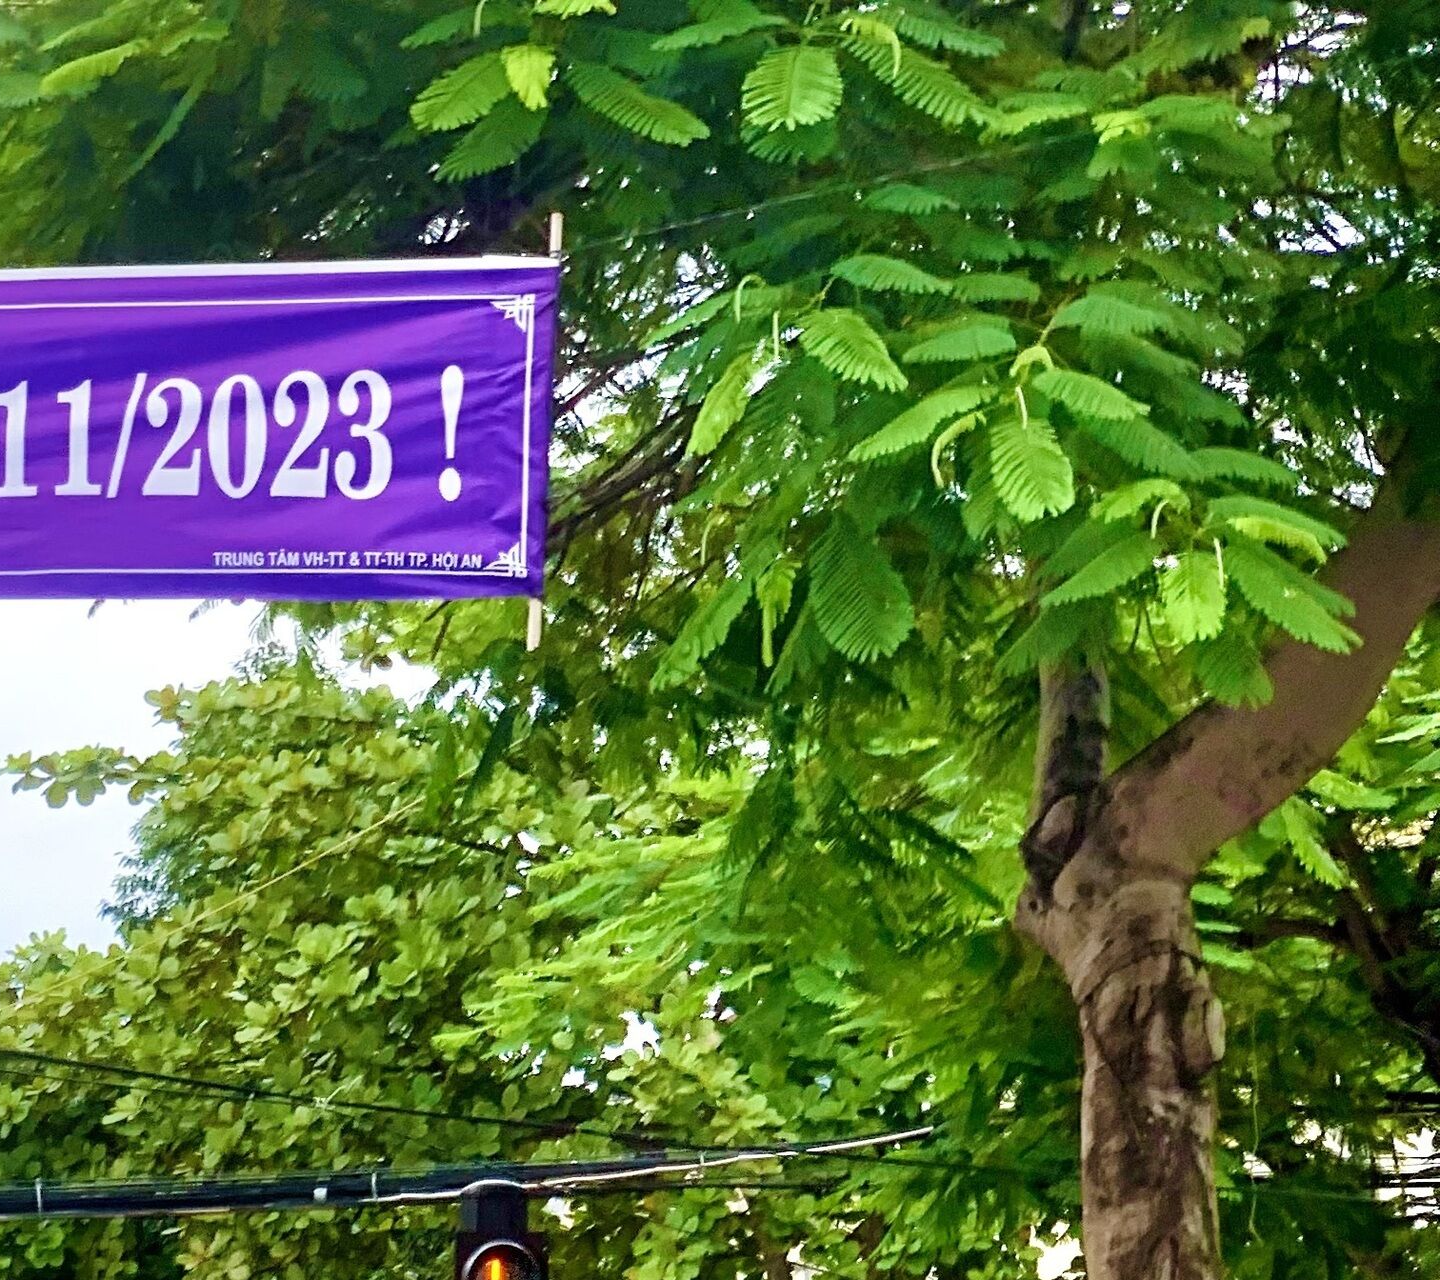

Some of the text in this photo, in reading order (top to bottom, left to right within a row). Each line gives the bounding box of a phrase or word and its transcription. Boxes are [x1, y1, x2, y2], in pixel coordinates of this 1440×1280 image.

[438, 364, 465, 502] !
[212, 551, 265, 567] TRUNG
[268, 548, 300, 567] TÂM
[303, 551, 347, 567] VH-TT
[349, 551, 360, 567] &
[364, 551, 405, 567] TT-TH
[408, 551, 429, 568] TP.
[461, 553, 483, 569] AN
